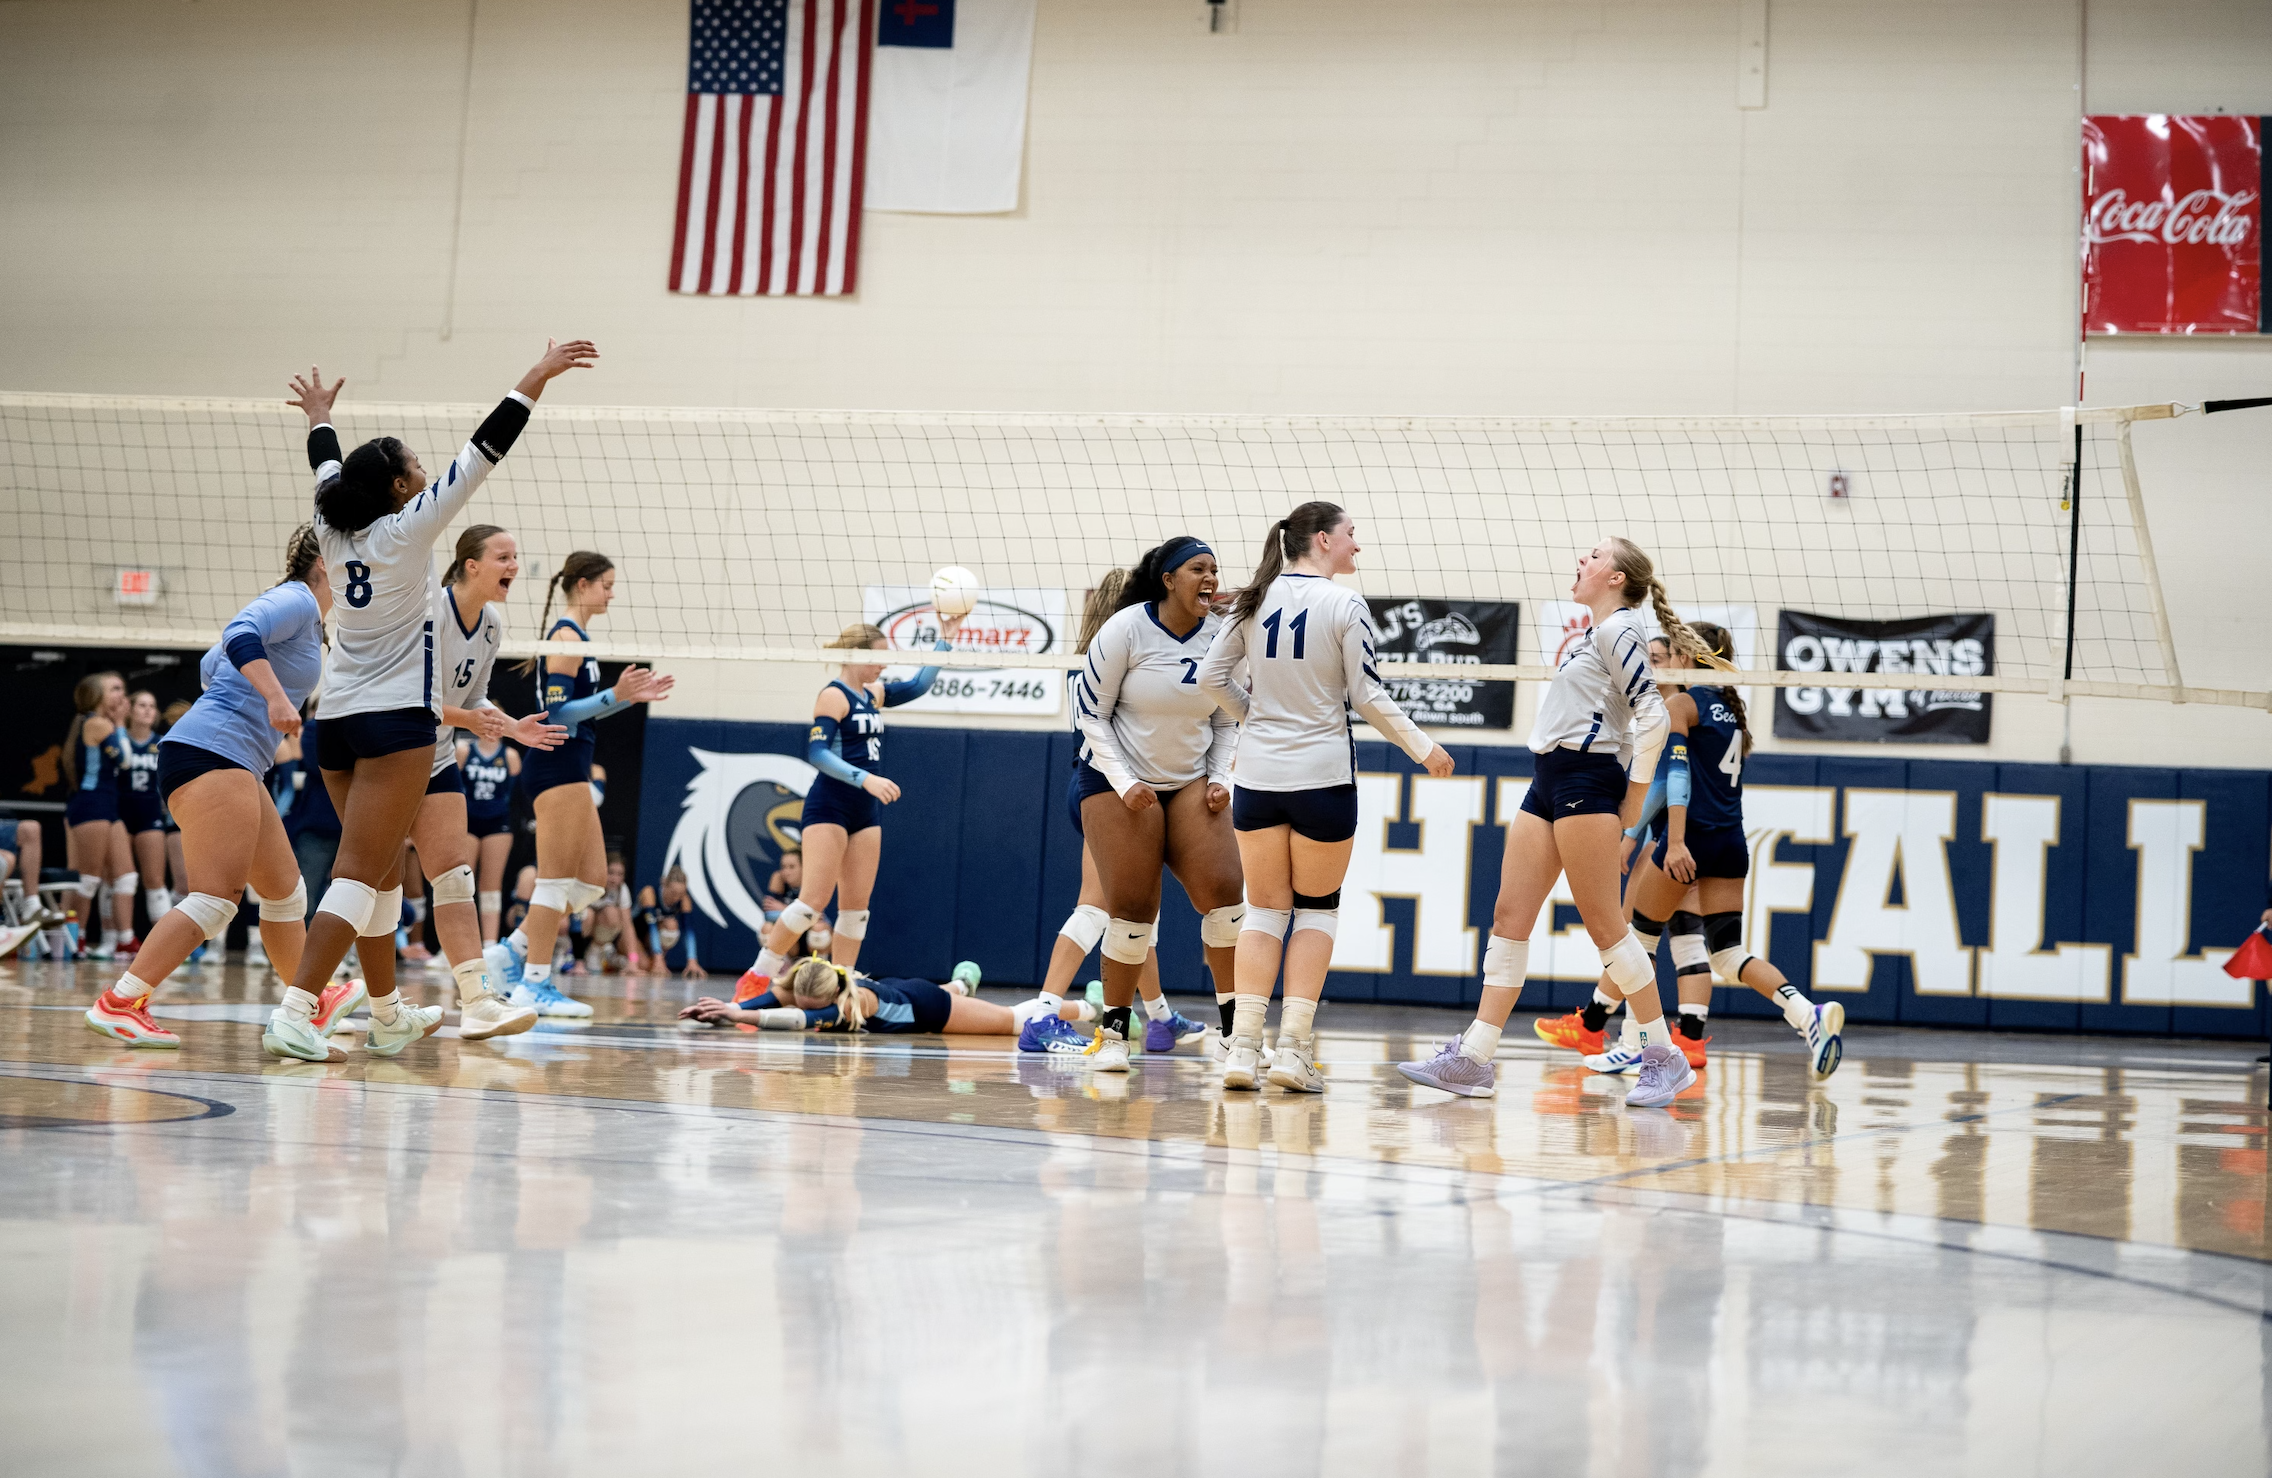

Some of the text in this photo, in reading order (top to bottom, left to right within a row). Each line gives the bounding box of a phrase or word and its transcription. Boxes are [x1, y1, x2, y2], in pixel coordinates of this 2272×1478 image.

[345, 560, 373, 608] 8
[911, 618, 1032, 646] jamarz
[1262, 607, 1309, 660] 11
[1180, 657, 1198, 684] 2
[1785, 635, 1986, 676] OWENS
[451, 658, 475, 688] 15
[1381, 682, 1474, 703] -776-2200
[1785, 686, 1909, 718] GYM
[851, 713, 885, 734] TM
[466, 764, 507, 783] TMU
[1718, 728, 1743, 788] 4
[1710, 782, 2256, 1008] FALL
